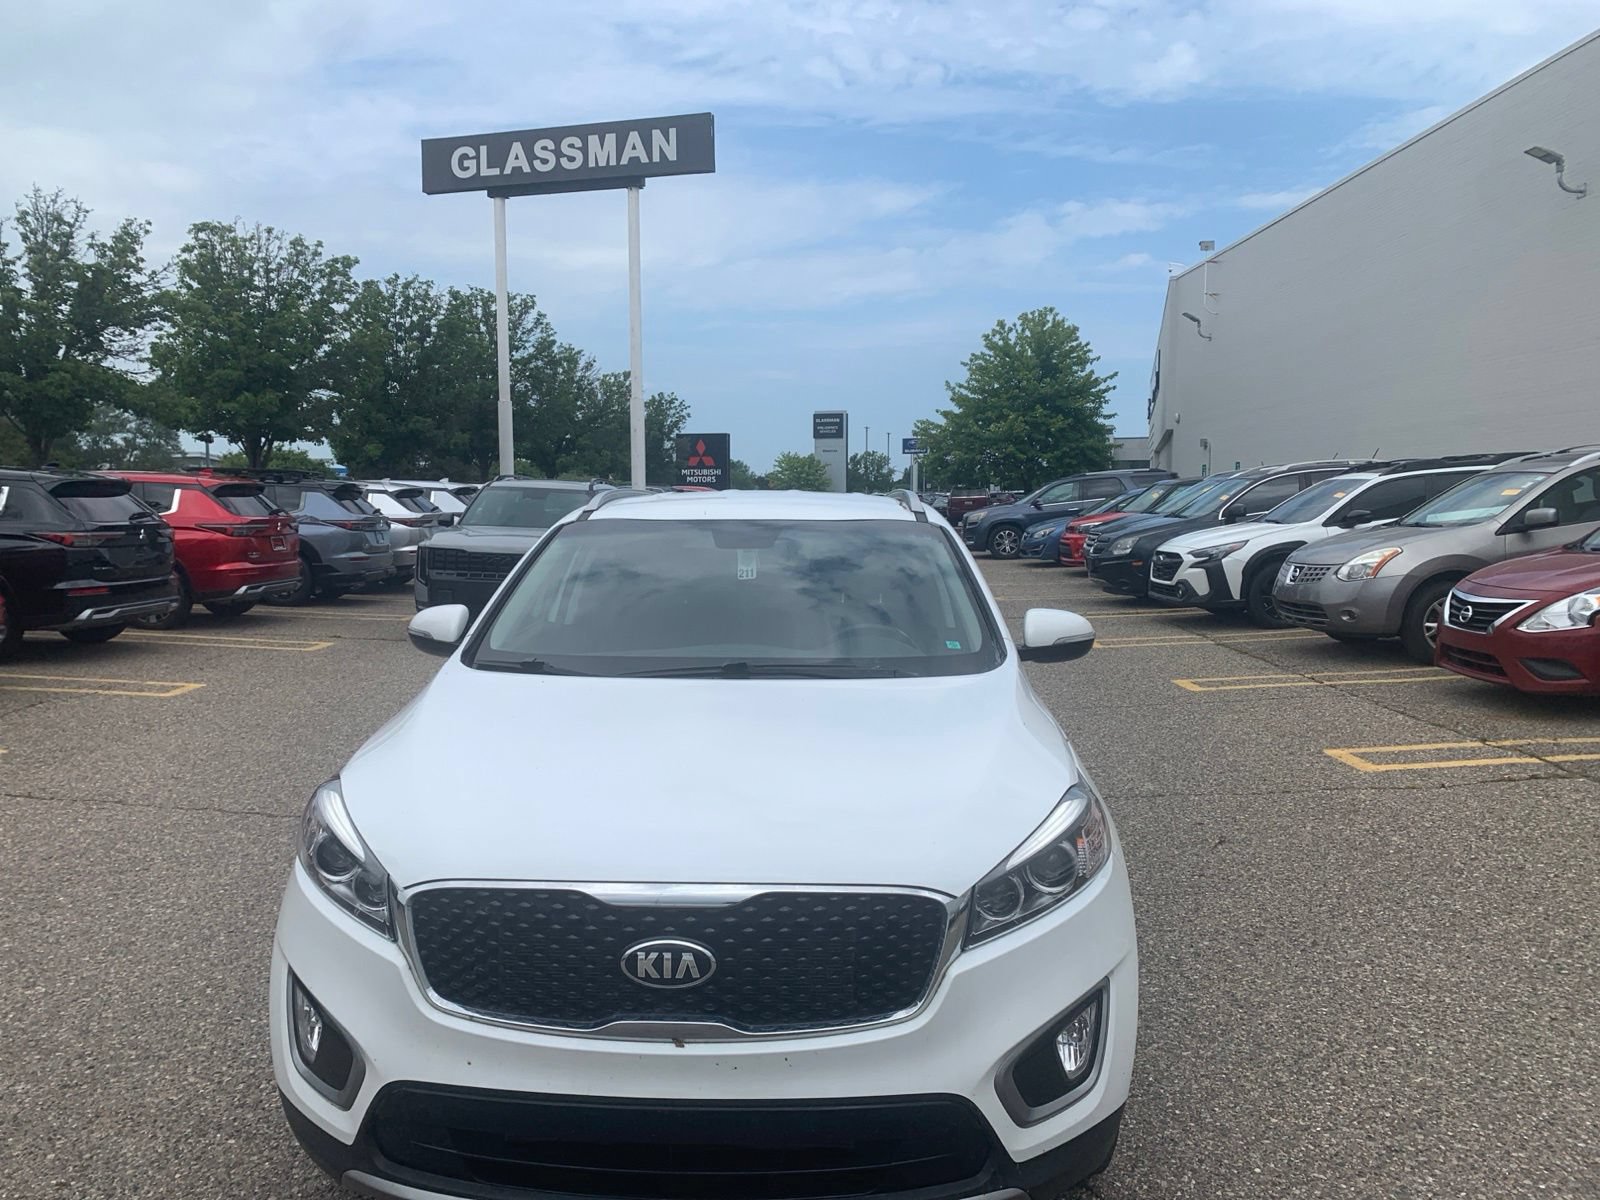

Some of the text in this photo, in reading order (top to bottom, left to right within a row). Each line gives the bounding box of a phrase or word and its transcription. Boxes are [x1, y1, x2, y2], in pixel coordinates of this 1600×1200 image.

[450, 127, 677, 179] GLASSMAN
[738, 568, 754, 578] 211
[636, 951, 701, 979] KIA
